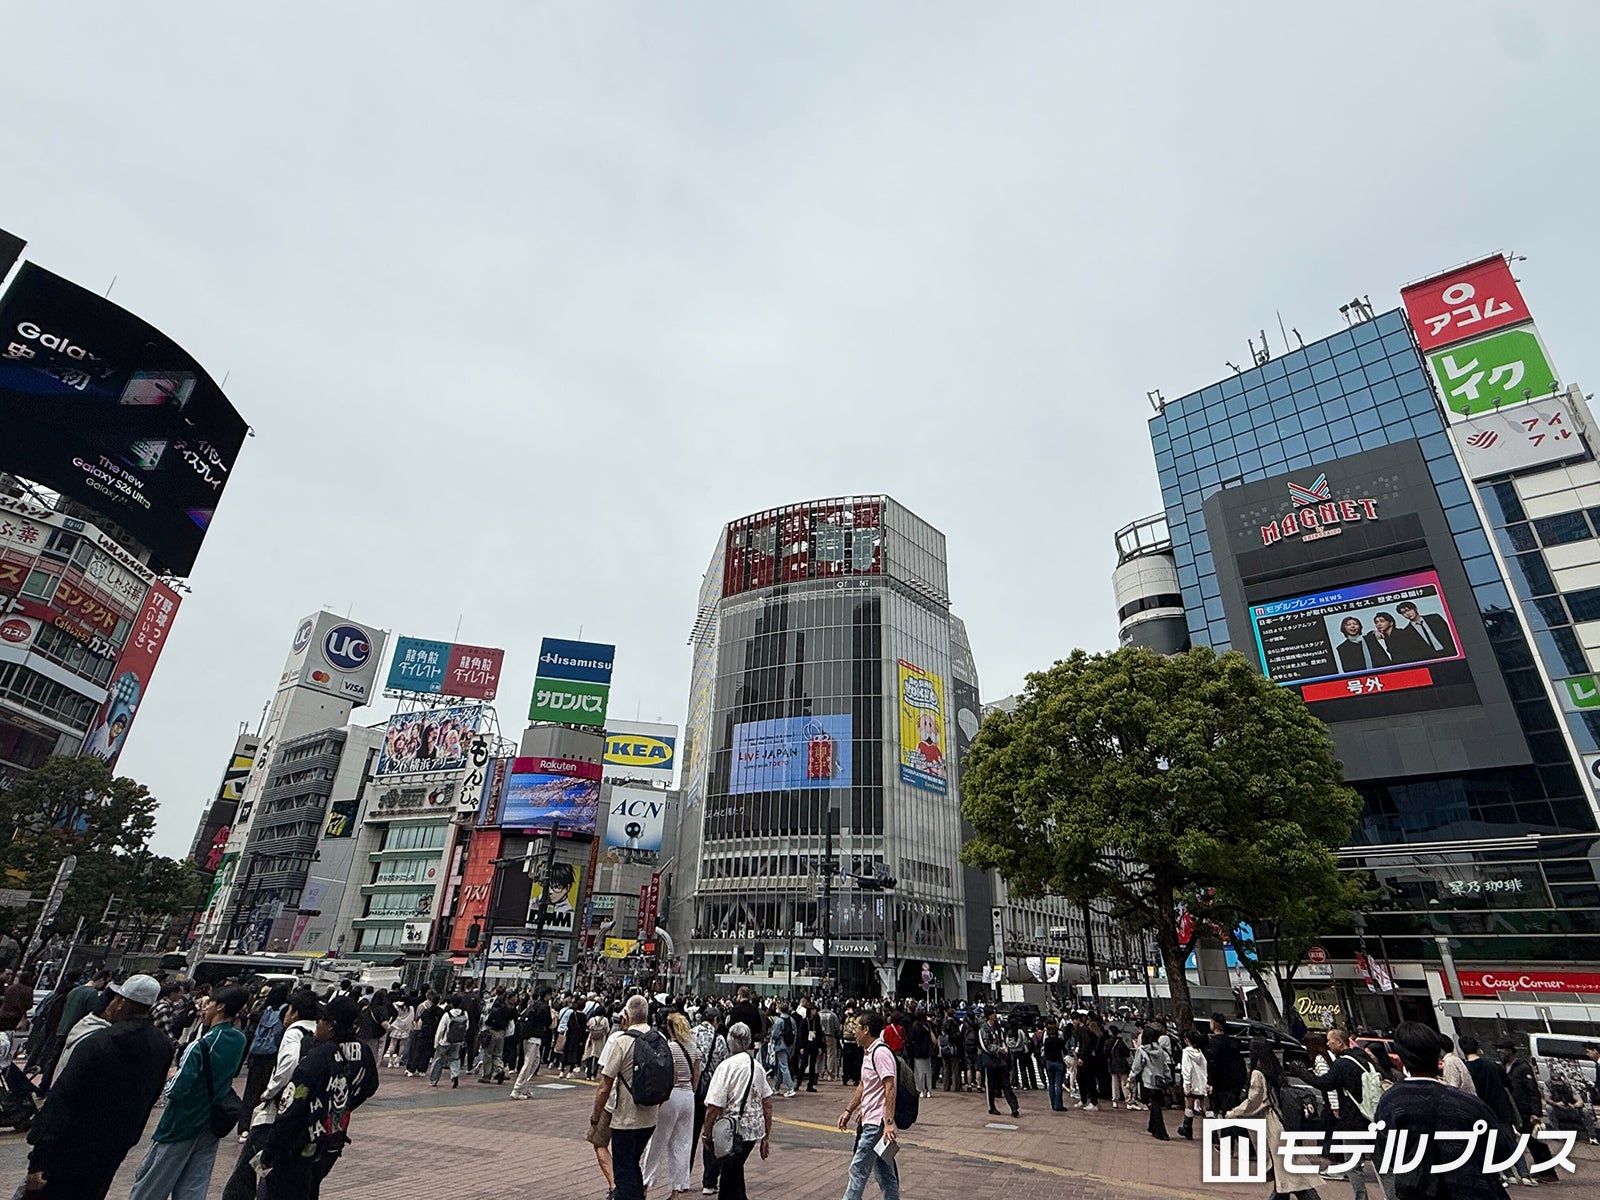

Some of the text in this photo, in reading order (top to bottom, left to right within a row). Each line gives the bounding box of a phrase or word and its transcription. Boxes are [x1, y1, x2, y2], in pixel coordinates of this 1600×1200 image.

[1423, 297, 1514, 337] アコム
[17, 322, 101, 360] Gala
[1441, 355, 1525, 401] レイク
[99, 455, 144, 489] The new
[72, 457, 151, 509] Galaxy S26 Ultra
[86, 478, 119, 500] Galaxy
[1261, 499, 1378, 546] MAGNET
[107, 567, 143, 601] しゃぶ葉
[55, 583, 115, 628] コンタクト
[1267, 597, 1316, 613] モデルプレス
[1319, 593, 1343, 603] NEWS
[2, 627, 27, 638] ガスト
[146, 600, 174, 654] 野球って
[88, 635, 117, 659] ガスト
[328, 631, 369, 662] UC
[405, 648, 440, 665] 龍角散
[398, 661, 442, 678] ダイレクト
[459, 655, 493, 671] 龍角散
[540, 653, 612, 671] Hisamitsu
[453, 668, 495, 685] ダイレクト
[1346, 676, 1384, 694] 号外
[344, 681, 365, 694] VISA
[536, 690, 603, 713] サロンパス
[604, 741, 667, 759] IKEA
[738, 747, 798, 761] LIVE JAPAN
[381, 755, 468, 774] 4.26 横浜アリーナ
[459, 736, 489, 810] もんじゃ
[540, 759, 577, 772] Rakuten
[611, 799, 664, 819] ACN
[713, 929, 793, 939] STARBK
[1481, 974, 1520, 992] Cozy
[1519, 976, 1565, 988] Corner
